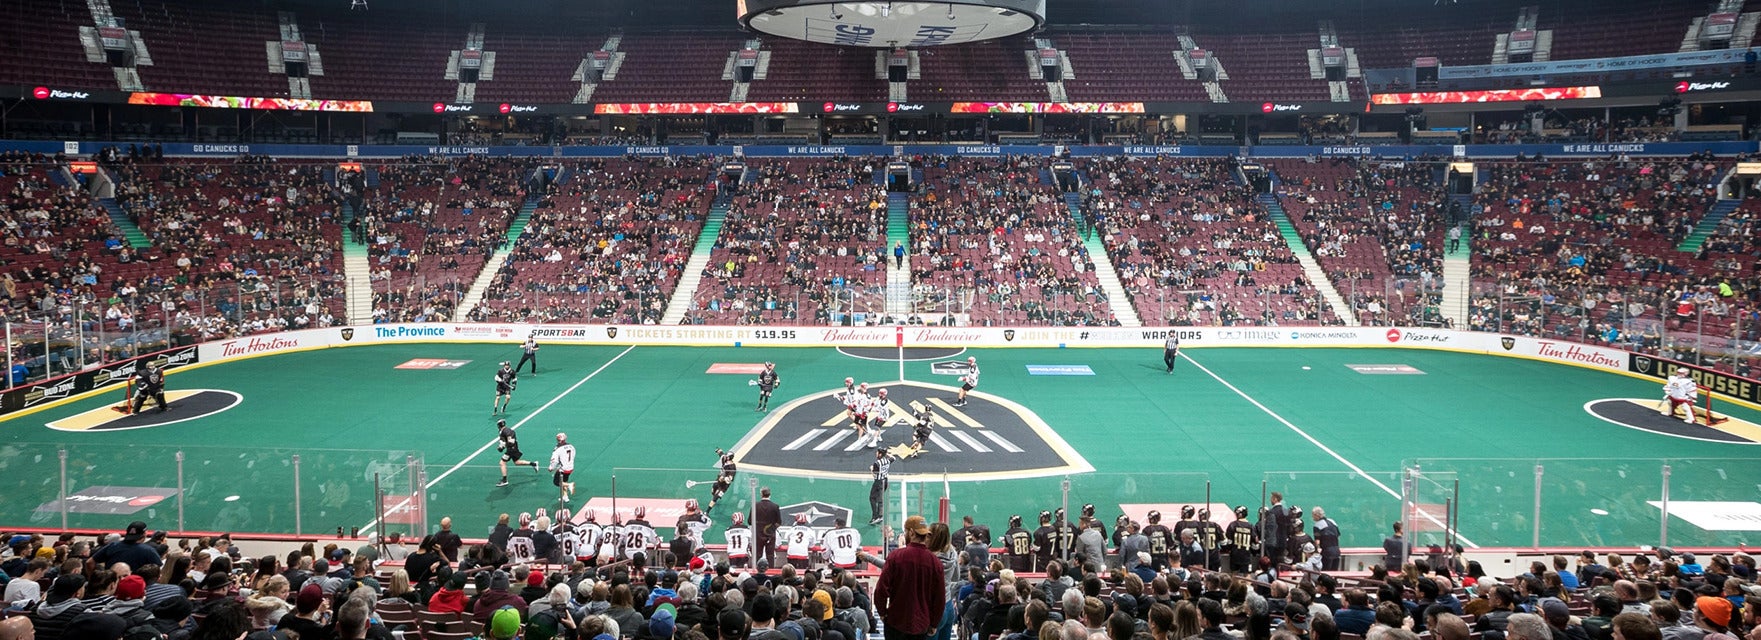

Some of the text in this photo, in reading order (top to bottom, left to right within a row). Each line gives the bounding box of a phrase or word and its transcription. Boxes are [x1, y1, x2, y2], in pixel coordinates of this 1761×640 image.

[50, 90, 72, 99] Pizza
[376, 326, 445, 337] The Province
[532, 329, 586, 337] SPORTSBAR
[626, 330, 796, 339] TICKETS STARTING AT $19.95
[821, 329, 888, 341] Budweiser
[914, 329, 981, 341] Budweiser
[1021, 331, 1048, 340] JOIN
[1052, 331, 1075, 340] THE
[1142, 331, 1202, 340] WARIORS
[1244, 328, 1280, 340] image
[1404, 332, 1449, 341] Pizza Hut
[222, 338, 298, 356] Tim Hortons
[180, 351, 195, 360] ZONE
[1538, 341, 1620, 368] Tim Hortons
[122, 366, 136, 375] ZONE
[1657, 362, 1750, 398] LAROSSE
[44, 386, 58, 396] BUD
[59, 382, 75, 392] ZONE
[567, 449, 572, 462] 7
[580, 529, 592, 544] 21
[627, 531, 643, 548] 26
[731, 534, 742, 549] 11
[796, 531, 804, 544] 3
[838, 534, 852, 549] 00
[1234, 532, 1251, 550] 44
[514, 543, 529, 558] 18
[1013, 537, 1030, 555] 88
[1151, 537, 1167, 554] 25
